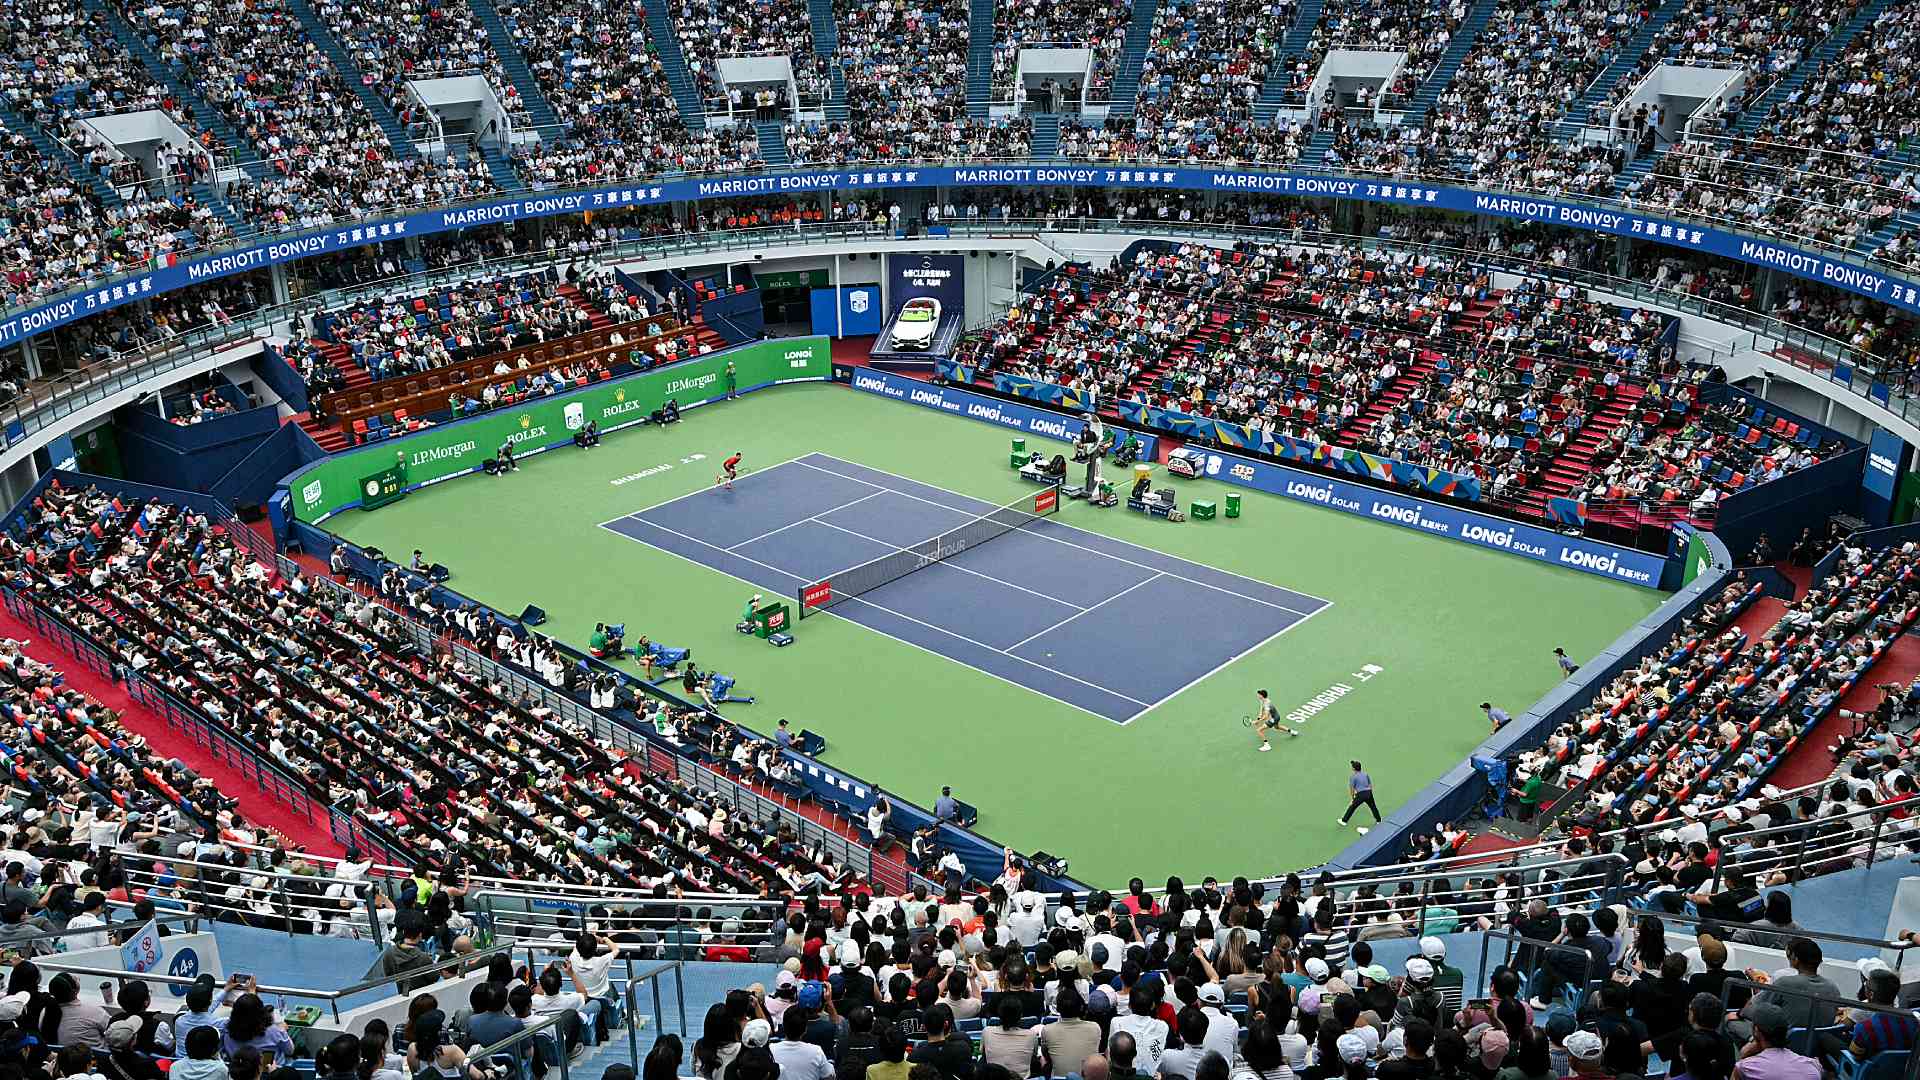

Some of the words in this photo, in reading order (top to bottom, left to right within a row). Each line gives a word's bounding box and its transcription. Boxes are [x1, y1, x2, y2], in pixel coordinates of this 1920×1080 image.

[700, 178, 776, 195] MARRIOTT
[780, 174, 840, 189] BONVOY
[955, 169, 1032, 182] MARRIOTT
[1037, 169, 1097, 182] BONVOY
[1213, 173, 1292, 191] MARRIOTT
[1297, 178, 1358, 195] BONVOY
[444, 202, 519, 226] MARRIOTT
[525, 195, 584, 214] BONVOY
[1476, 195, 1555, 218] MARRIOTT
[1560, 208, 1623, 229] BONVOY
[188, 248, 264, 279] MARRIOTT
[269, 235, 328, 260] BONVOY
[1742, 241, 1820, 275] MARRIOTT
[1824, 263, 1885, 293] BONVOY
[22, 299, 77, 332] BONVOY
[665, 372, 716, 395] J.P.Morgan
[885, 387, 904, 398] SOLAR
[602, 399, 641, 418] ROLEX
[1000, 415, 1022, 427] SOLAR
[507, 425, 547, 445] ROLEX
[411, 440, 476, 466] J.P.Morgan
[1331, 496, 1361, 512] SOLAR
[1513, 540, 1547, 557] SOLAR
[1286, 682, 1353, 723] SHANGHAI
